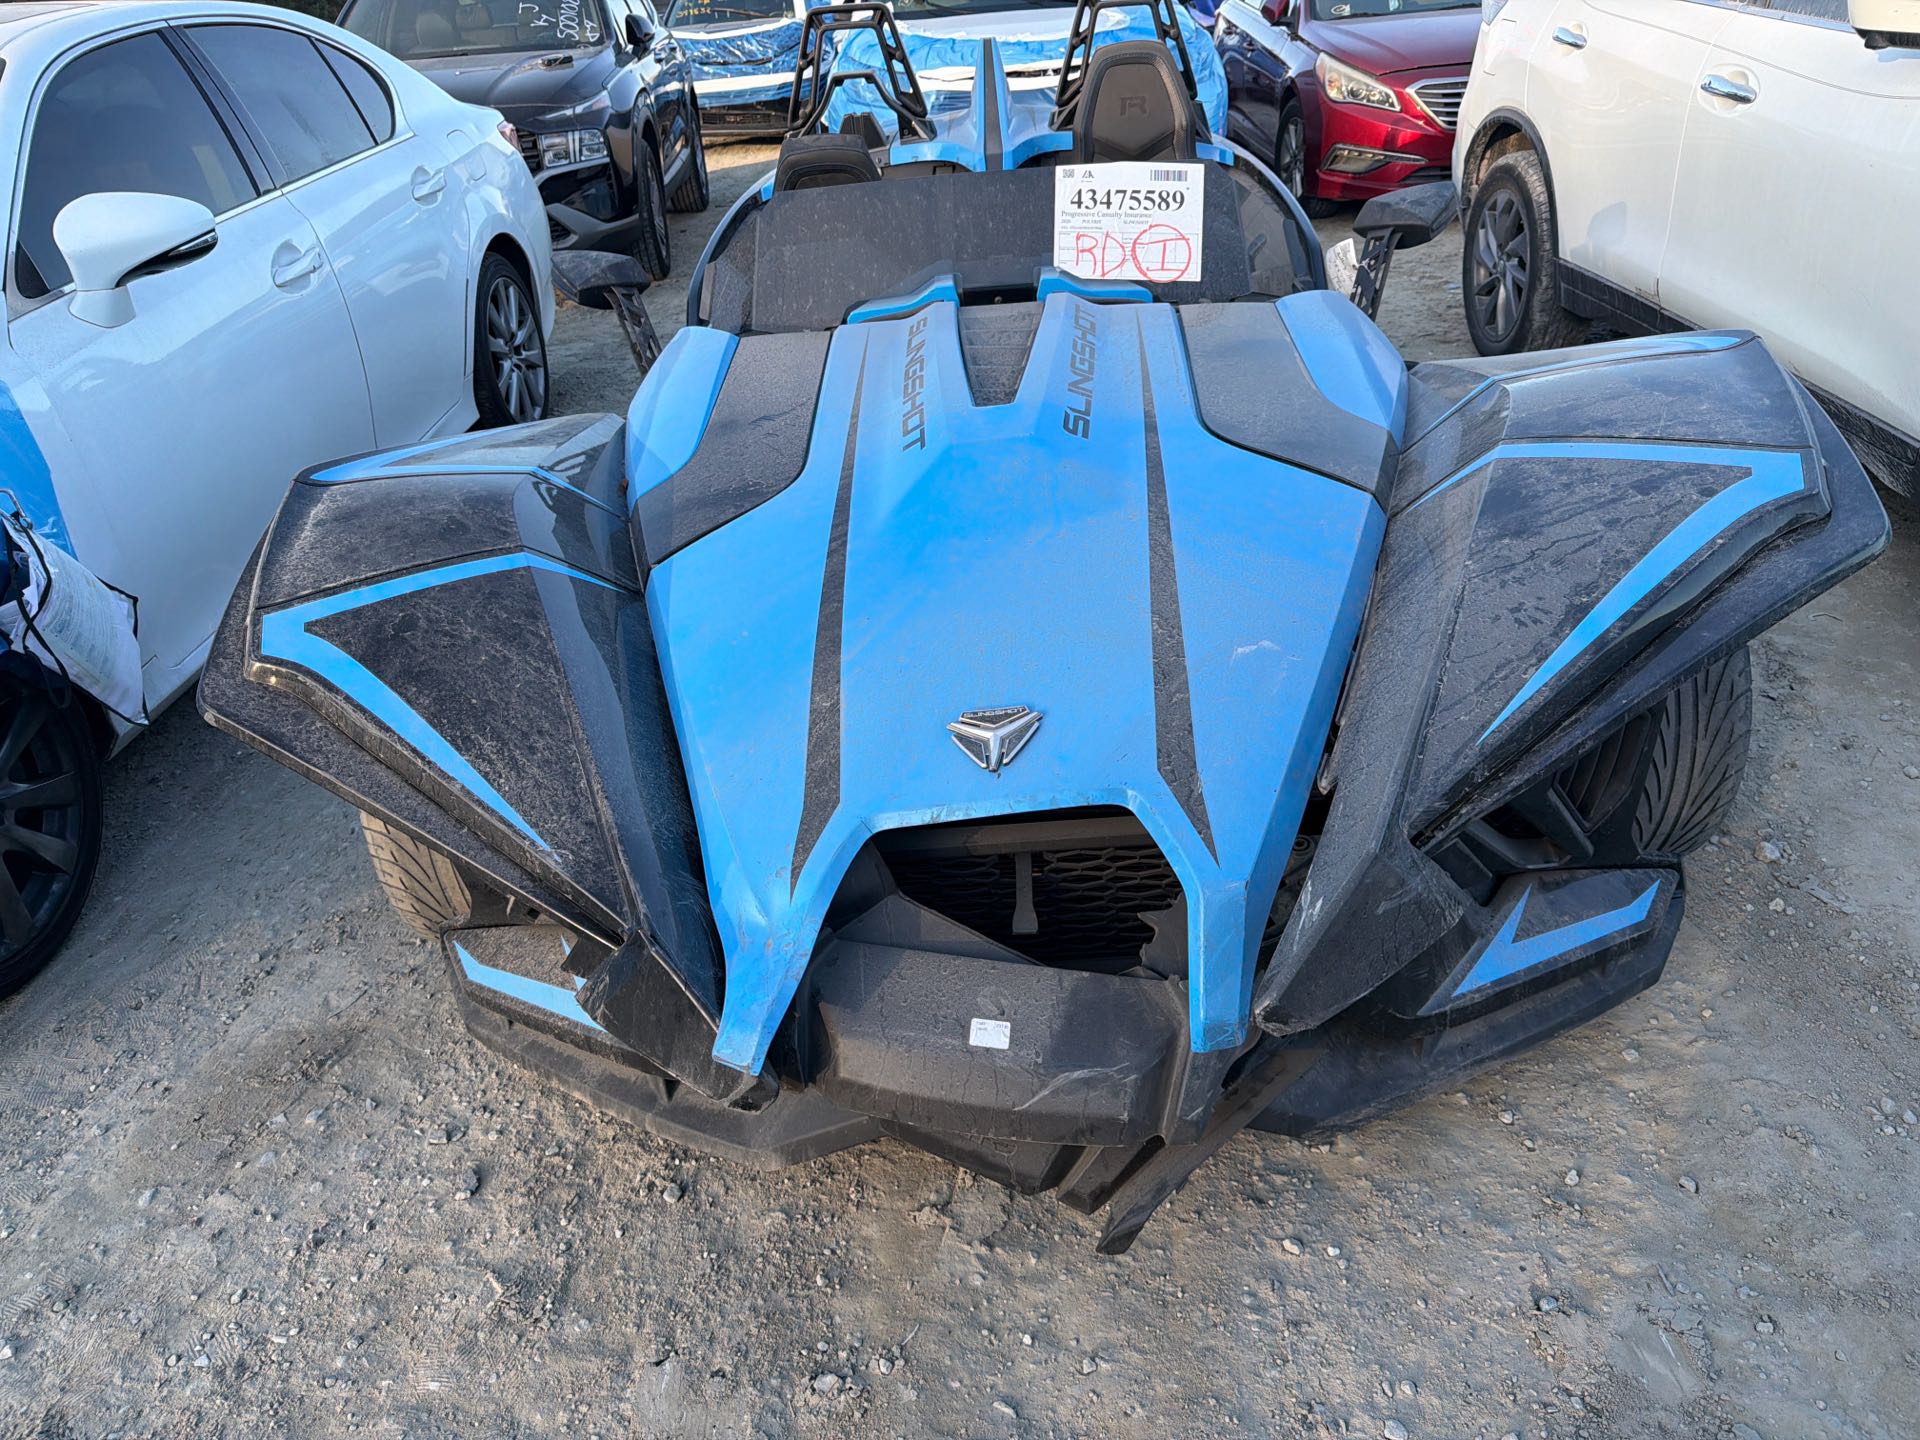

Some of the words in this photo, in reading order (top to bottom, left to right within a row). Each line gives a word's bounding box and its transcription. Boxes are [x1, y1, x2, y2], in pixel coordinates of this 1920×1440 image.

[1061, 211, 1096, 219] Progressive
[1097, 210, 1122, 220] Casualty
[1124, 211, 1153, 219] Insurance
[1070, 188, 1185, 212] 43475589
[1076, 230, 1126, 278] RD
[902, 317, 929, 452] SLINGSHOT
[1062, 303, 1097, 440] SLINGSHOT
